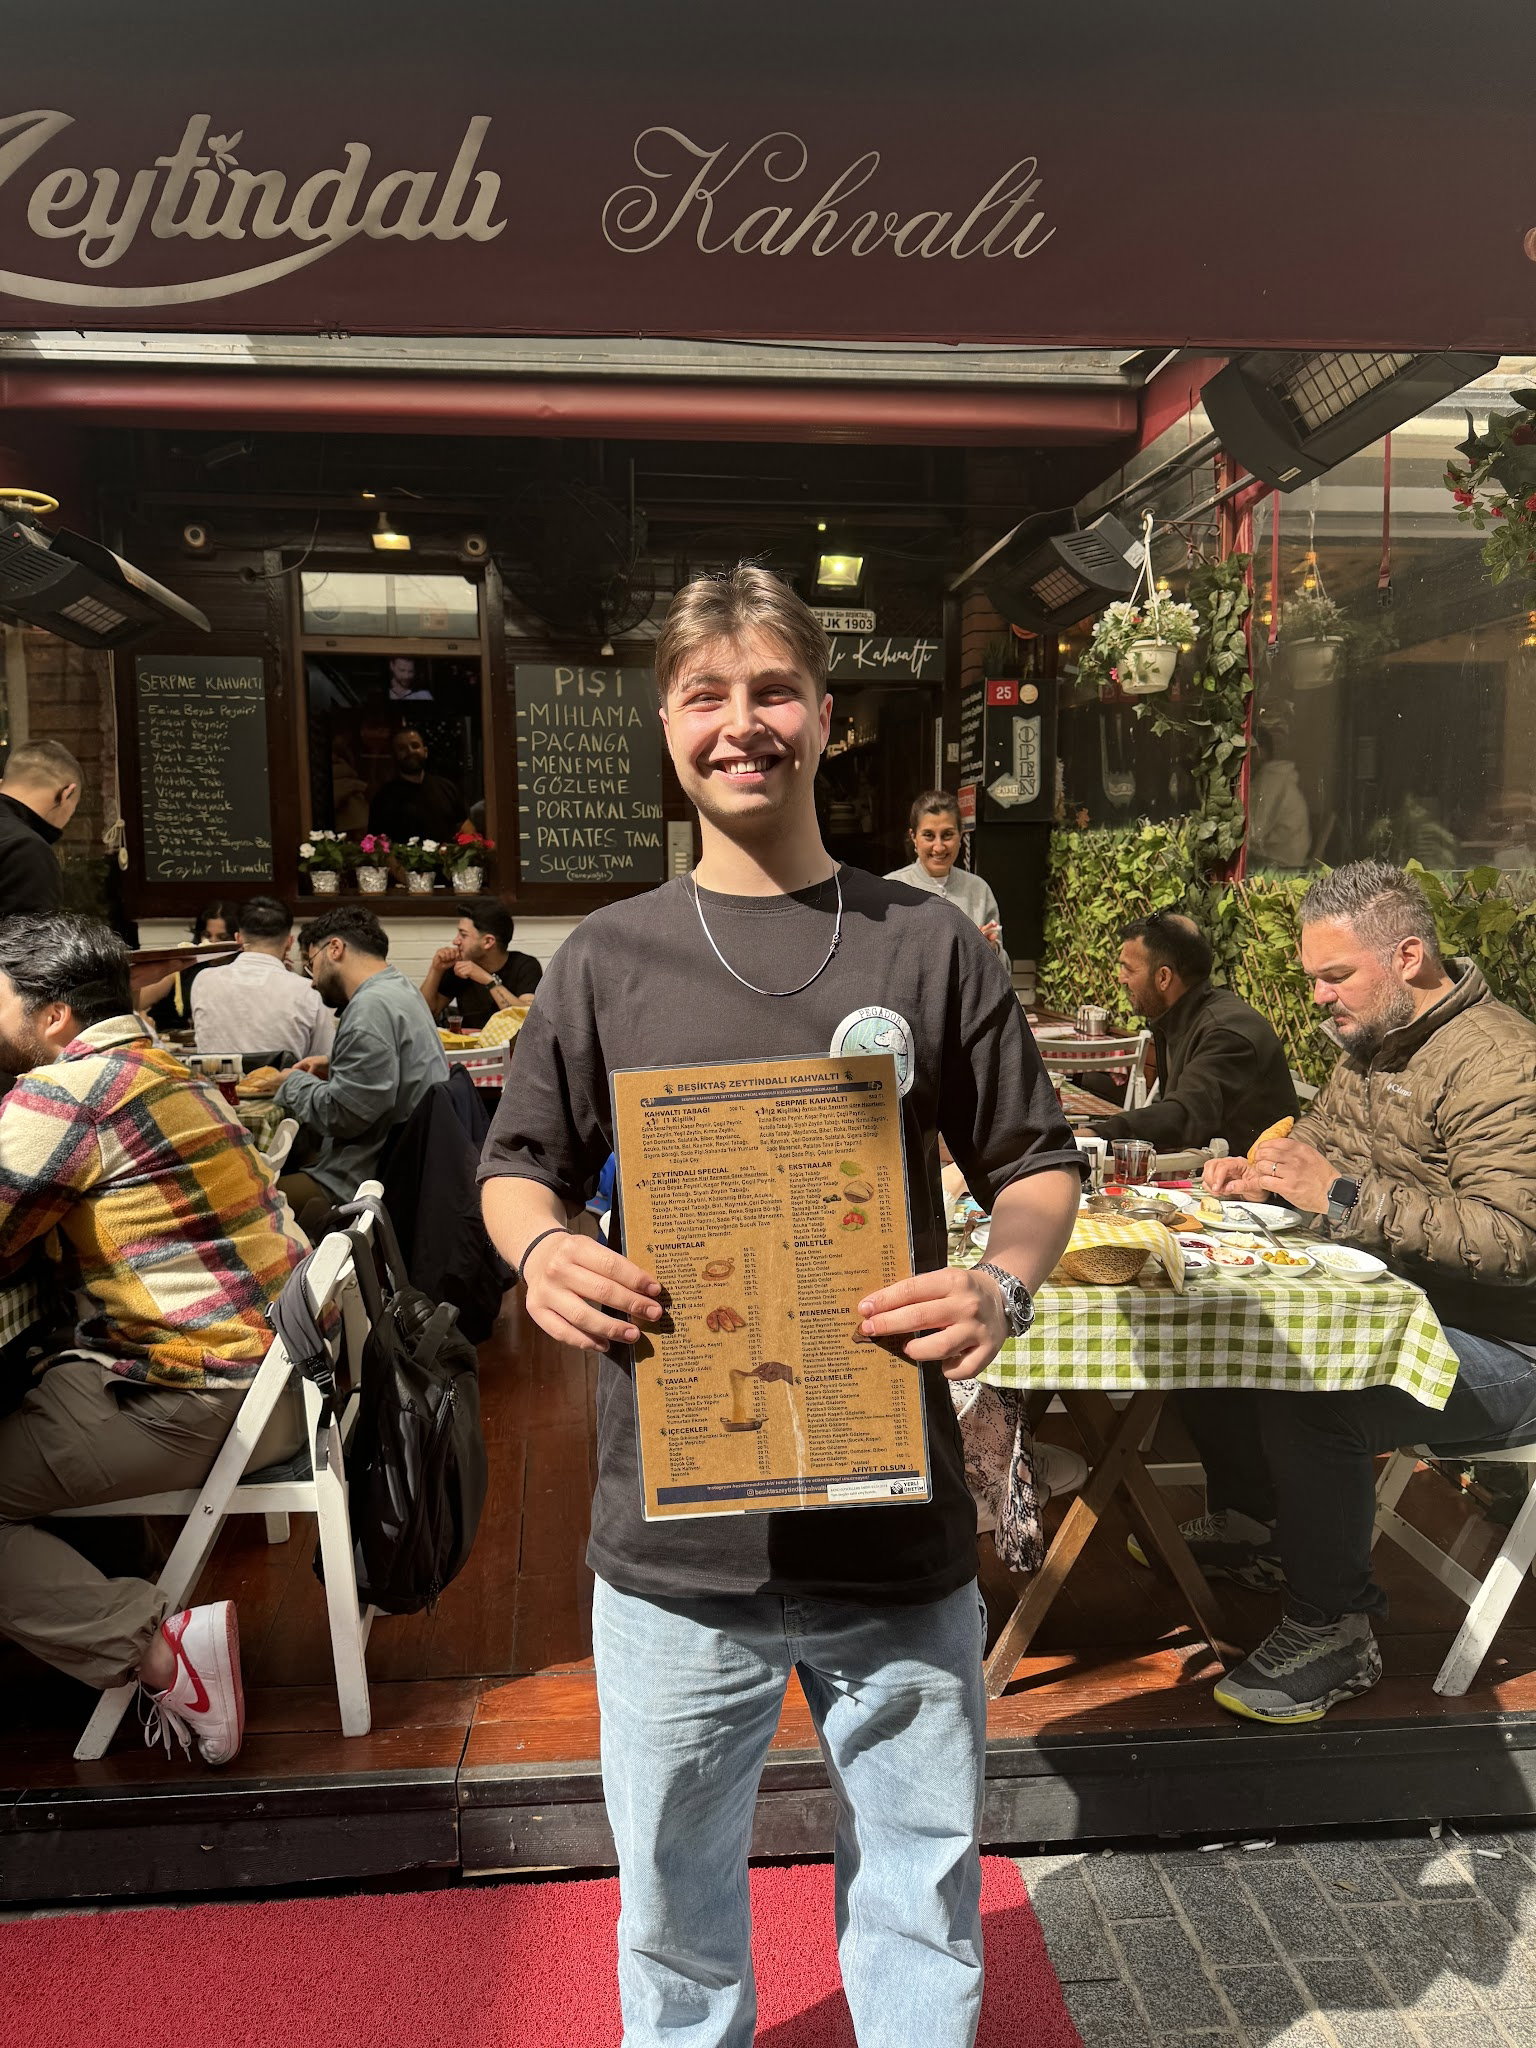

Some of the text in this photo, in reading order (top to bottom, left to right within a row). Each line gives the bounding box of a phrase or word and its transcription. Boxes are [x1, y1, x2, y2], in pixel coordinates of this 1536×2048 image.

[601, 126, 1056, 258] Kahvaltı
[844, 618, 873, 630] 1903
[852, 637, 938, 680] Kahvaltı
[139, 671, 262, 693] SERPME KAHVALTI
[996, 685, 1013, 700] 25
[529, 702, 643, 728] MIHLAMA
[531, 730, 630, 753] PAÇANGA
[532, 755, 631, 774] MENEMEN
[1018, 725, 1036, 796] OPEN
[533, 776, 632, 795] GÖZLEME
[536, 799, 663, 820] PORTAKAL SUYU
[536, 826, 617, 848] PATATES
[540, 853, 634, 874] SUCUK TAVA
[857, 1007, 903, 1025] PEGADOR
[677, 1072, 839, 1092] BEŞİKTAŞ ZEYTİNDALI KAHVALTI
[809, 1096, 847, 1104] KAHVALTI
[644, 1106, 710, 1117] KAHVALTI TABAĞI
[652, 1169, 696, 1178] ZEYTİNDALI
[697, 1167, 728, 1175] SPECIAL
[788, 1161, 831, 1169] EKSTRALAR
[654, 1241, 705, 1250] YUMURTALAR
[793, 1239, 833, 1247] OMLETLER
[799, 1307, 850, 1316] MENEMENLER
[665, 1376, 698, 1384] TAVALAR
[804, 1372, 852, 1382] GÖZLEMELER
[668, 1426, 708, 1434] İÇECEKLER
